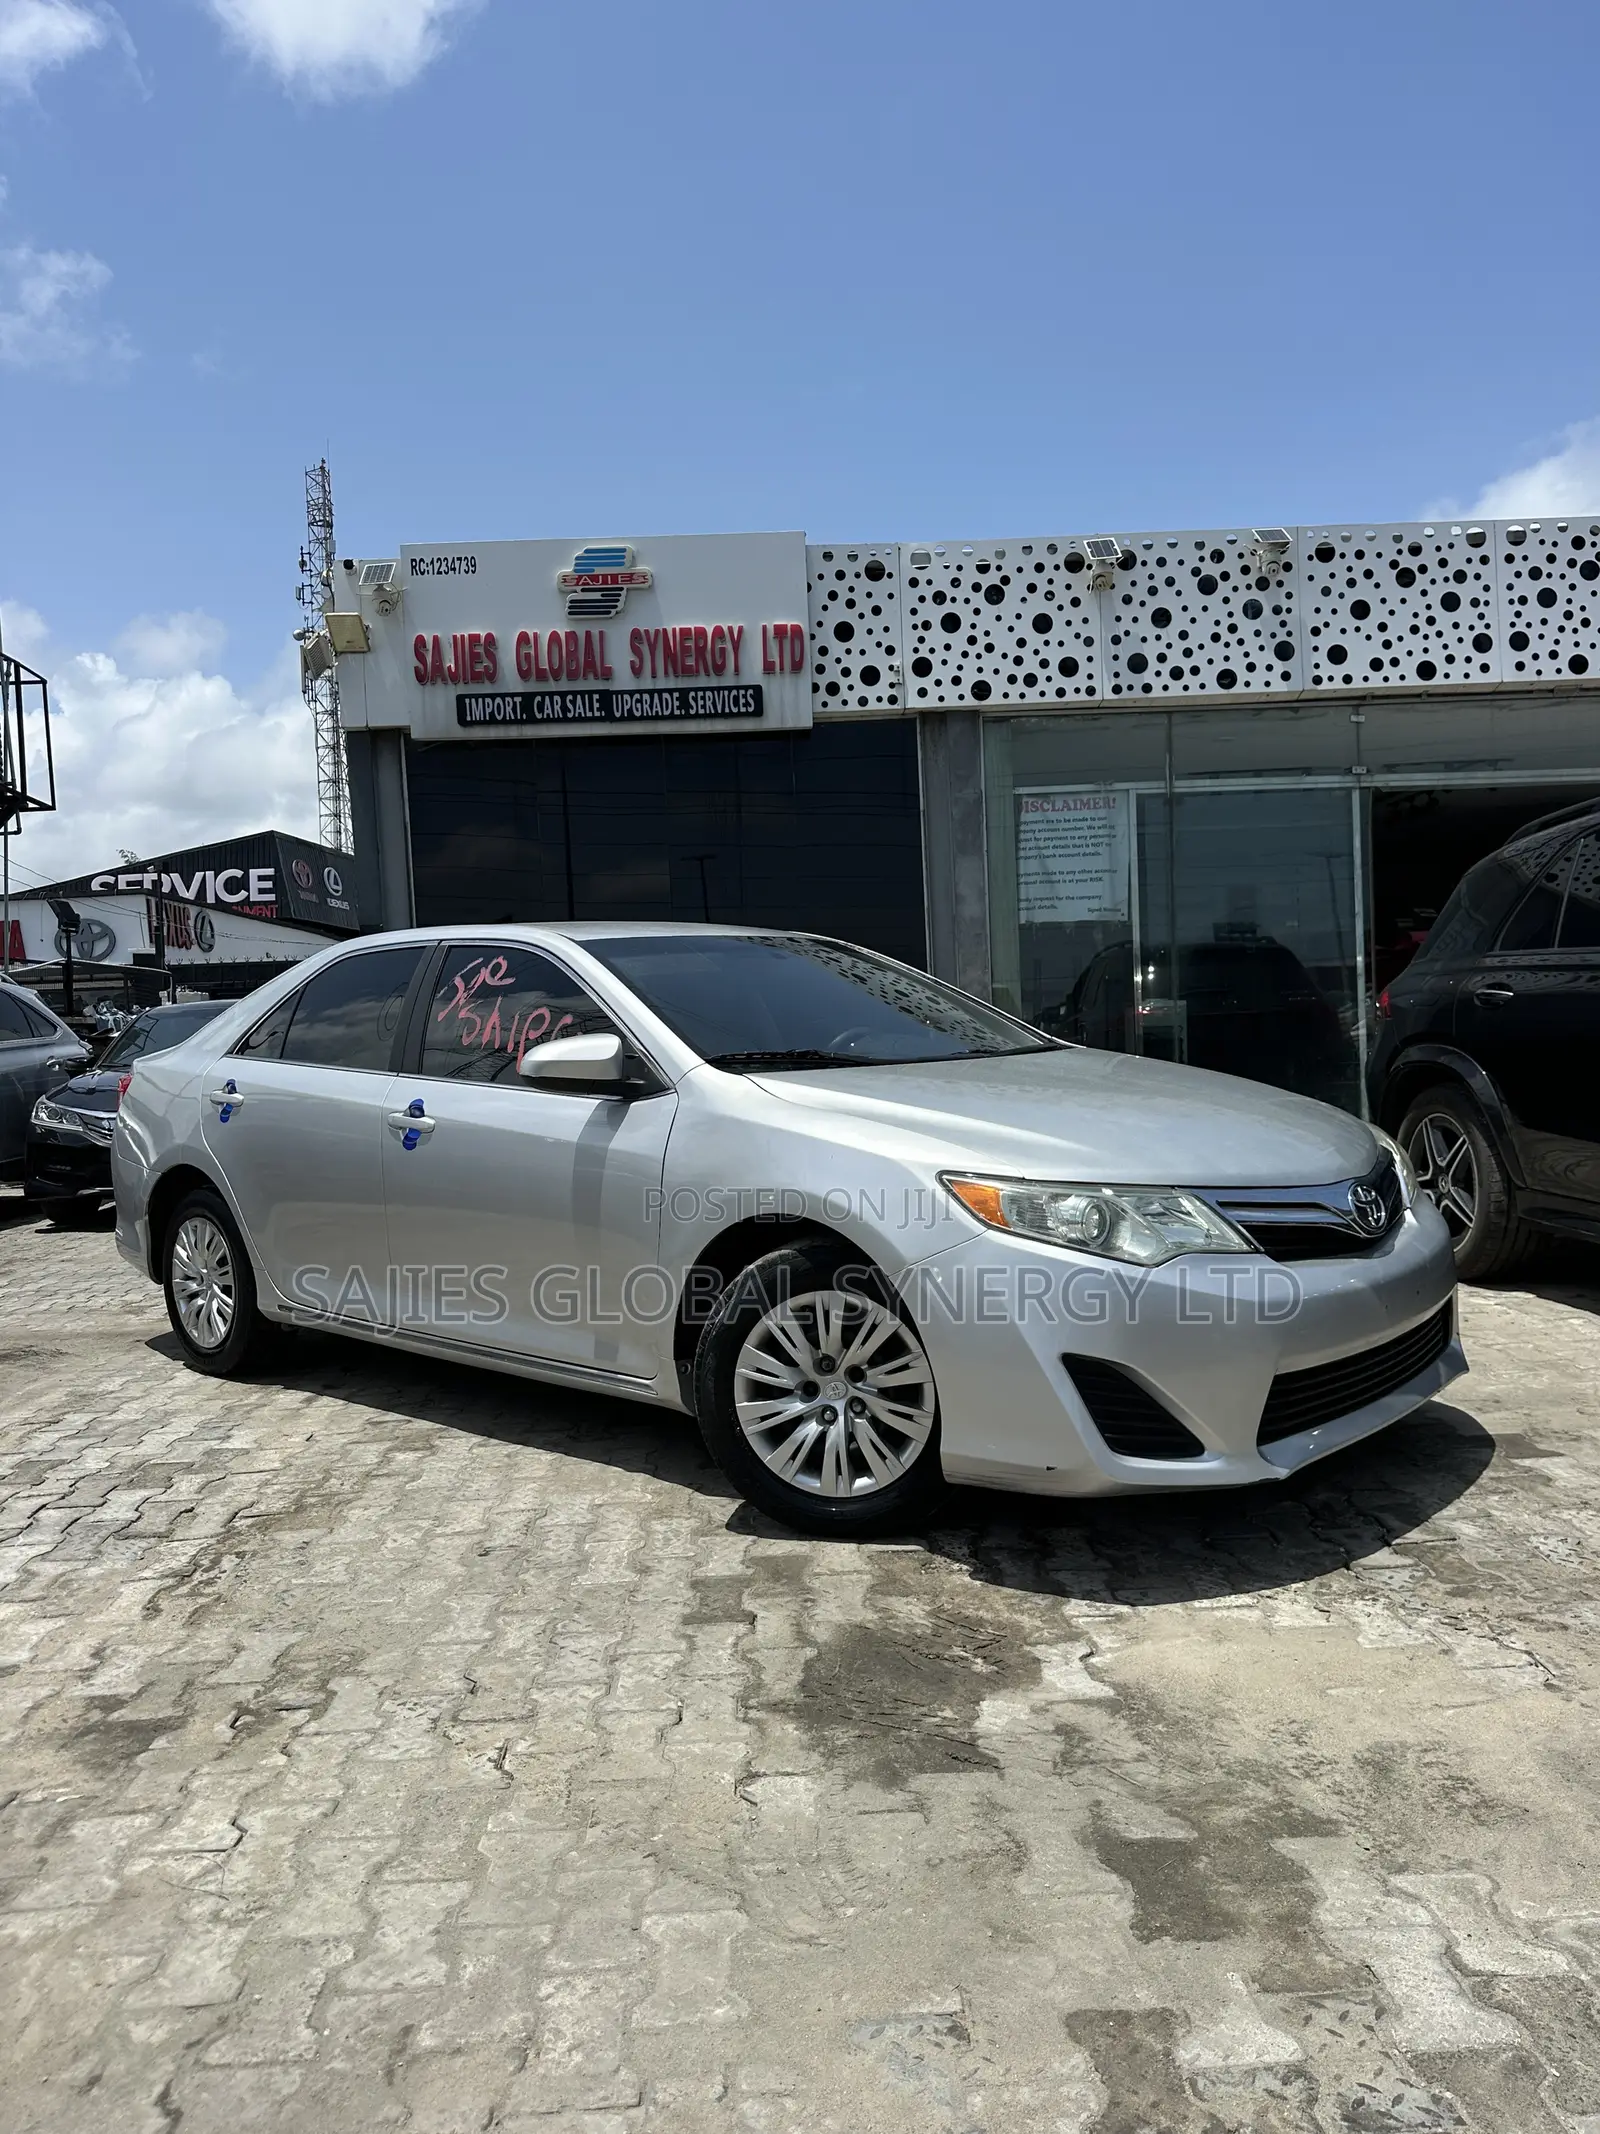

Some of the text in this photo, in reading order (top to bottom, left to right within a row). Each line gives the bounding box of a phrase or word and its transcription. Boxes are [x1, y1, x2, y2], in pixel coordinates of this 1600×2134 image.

[410, 556, 477, 576] RC:1234739
[563, 572, 647, 586] SAJIES
[414, 623, 805, 685] SAJIES GLOBAL SYNERGY LTD
[465, 688, 755, 722] IMPORT. CAR SALE. UPGRADE. SERVICES
[146, 897, 193, 950] LXUS
